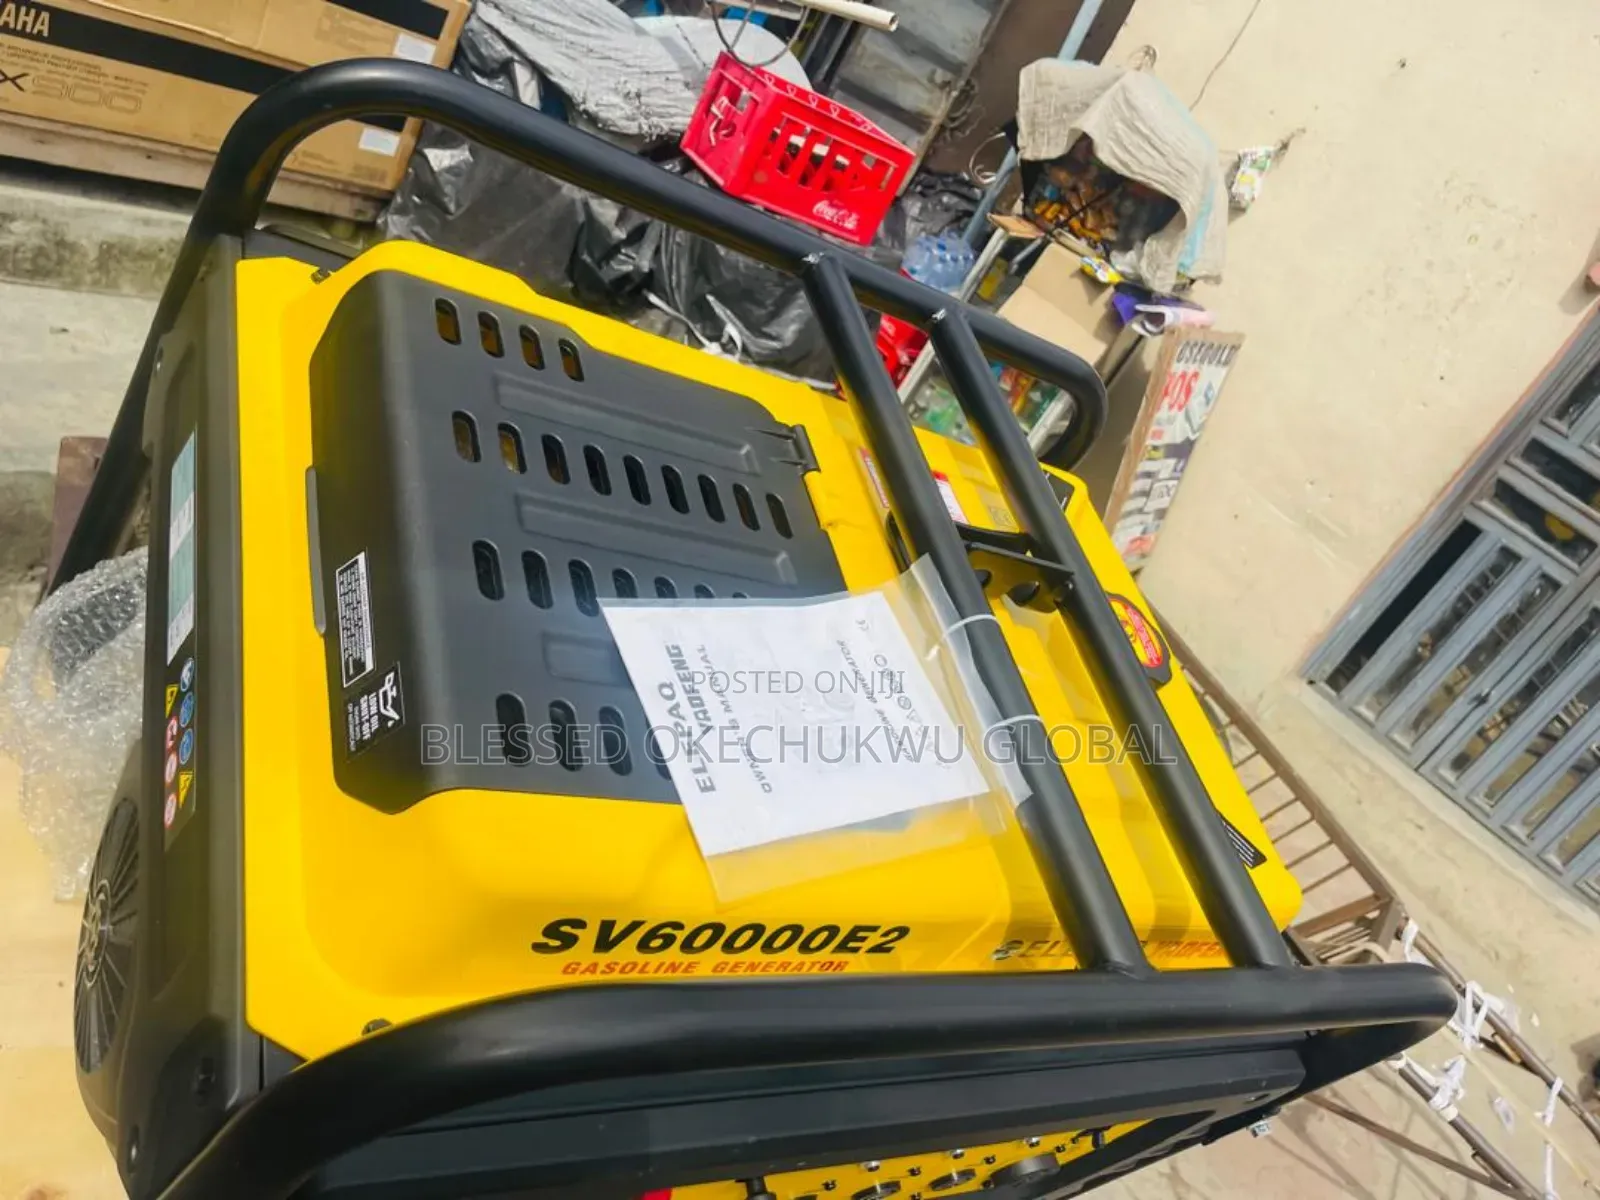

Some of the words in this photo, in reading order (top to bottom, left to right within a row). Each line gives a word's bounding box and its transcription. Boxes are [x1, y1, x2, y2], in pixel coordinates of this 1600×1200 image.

[531, 917, 911, 956] SV60000E2
[561, 960, 701, 976] GASOLINE
[711, 959, 851, 974] GENERATOR
